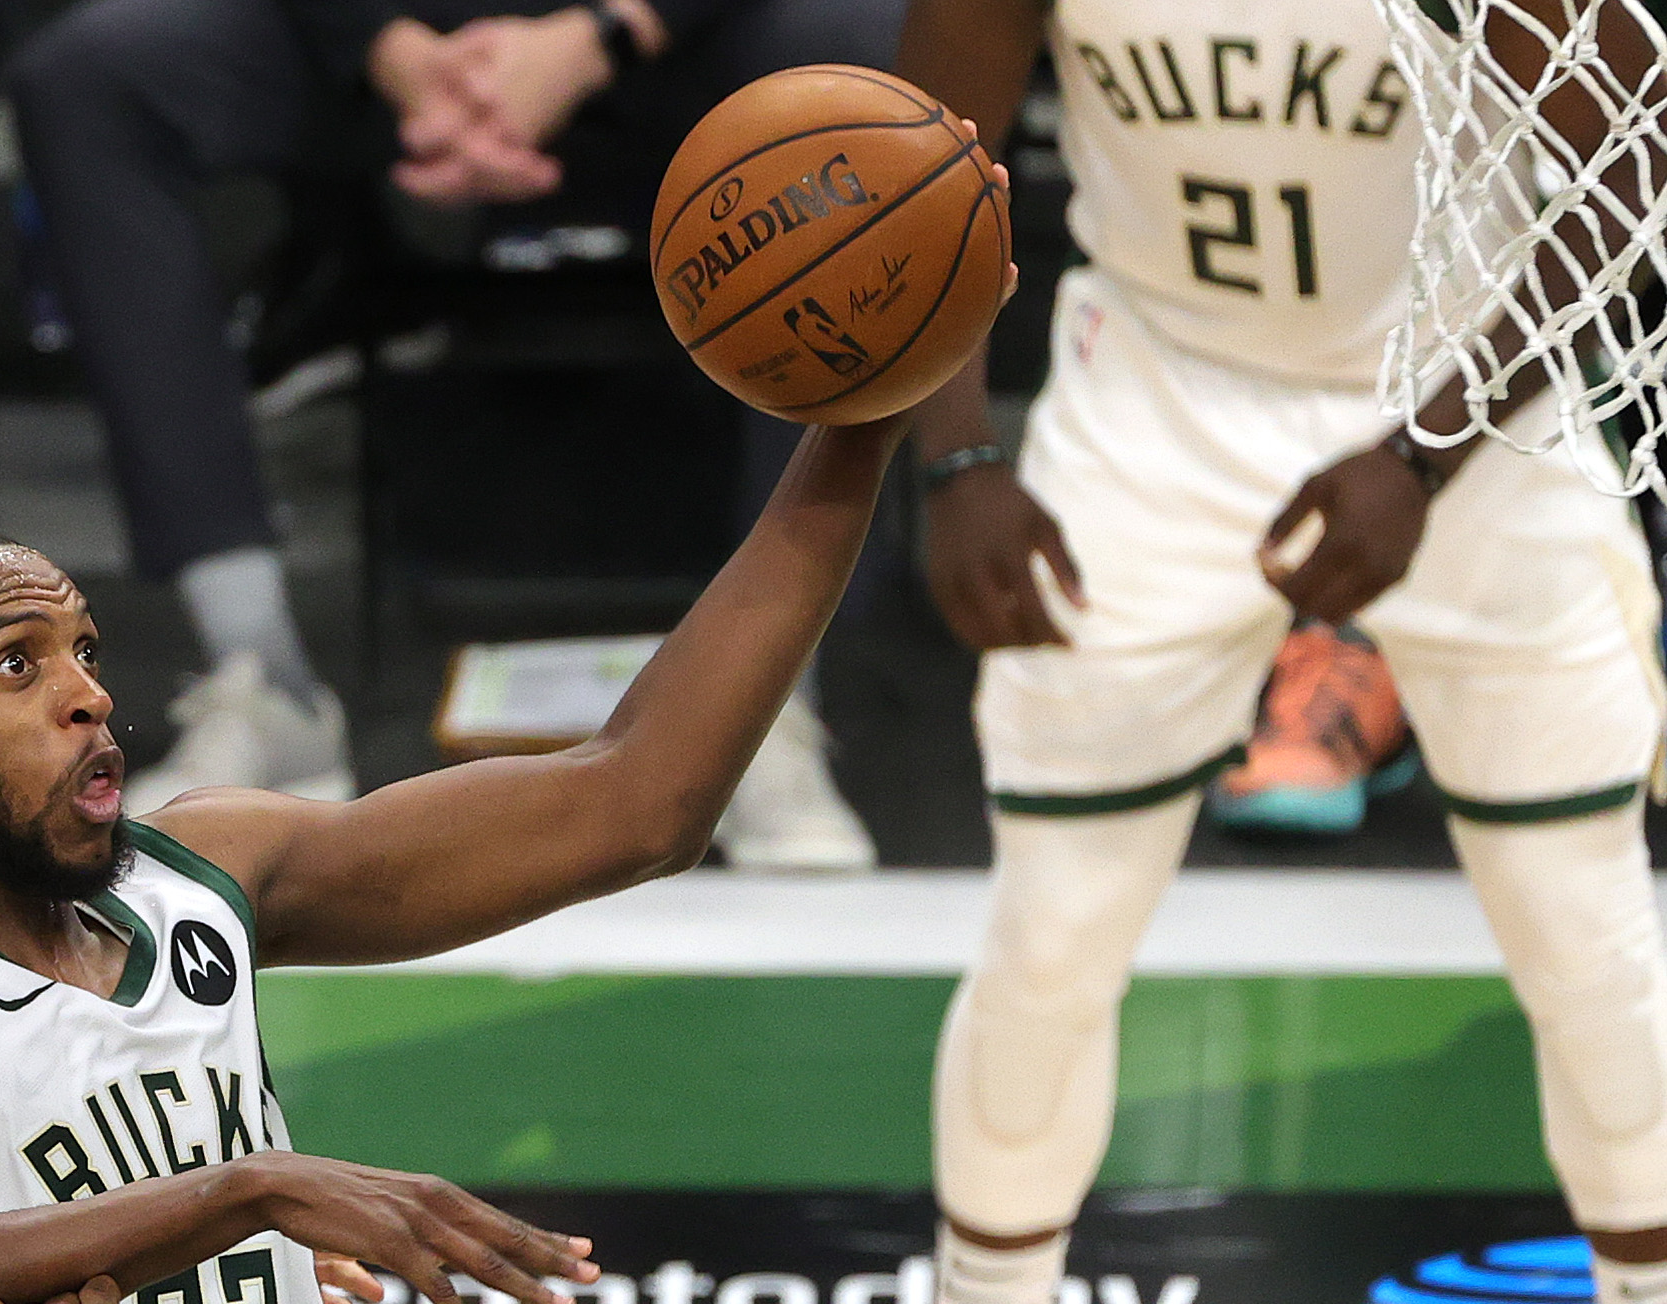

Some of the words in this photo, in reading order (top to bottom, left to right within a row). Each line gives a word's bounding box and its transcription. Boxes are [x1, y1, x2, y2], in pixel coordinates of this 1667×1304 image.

[1076, 35, 1413, 141] BUCKS
[666, 152, 870, 329] SPALDING
[1180, 172, 1320, 300] 21
[17, 1062, 277, 1204] BUCK
